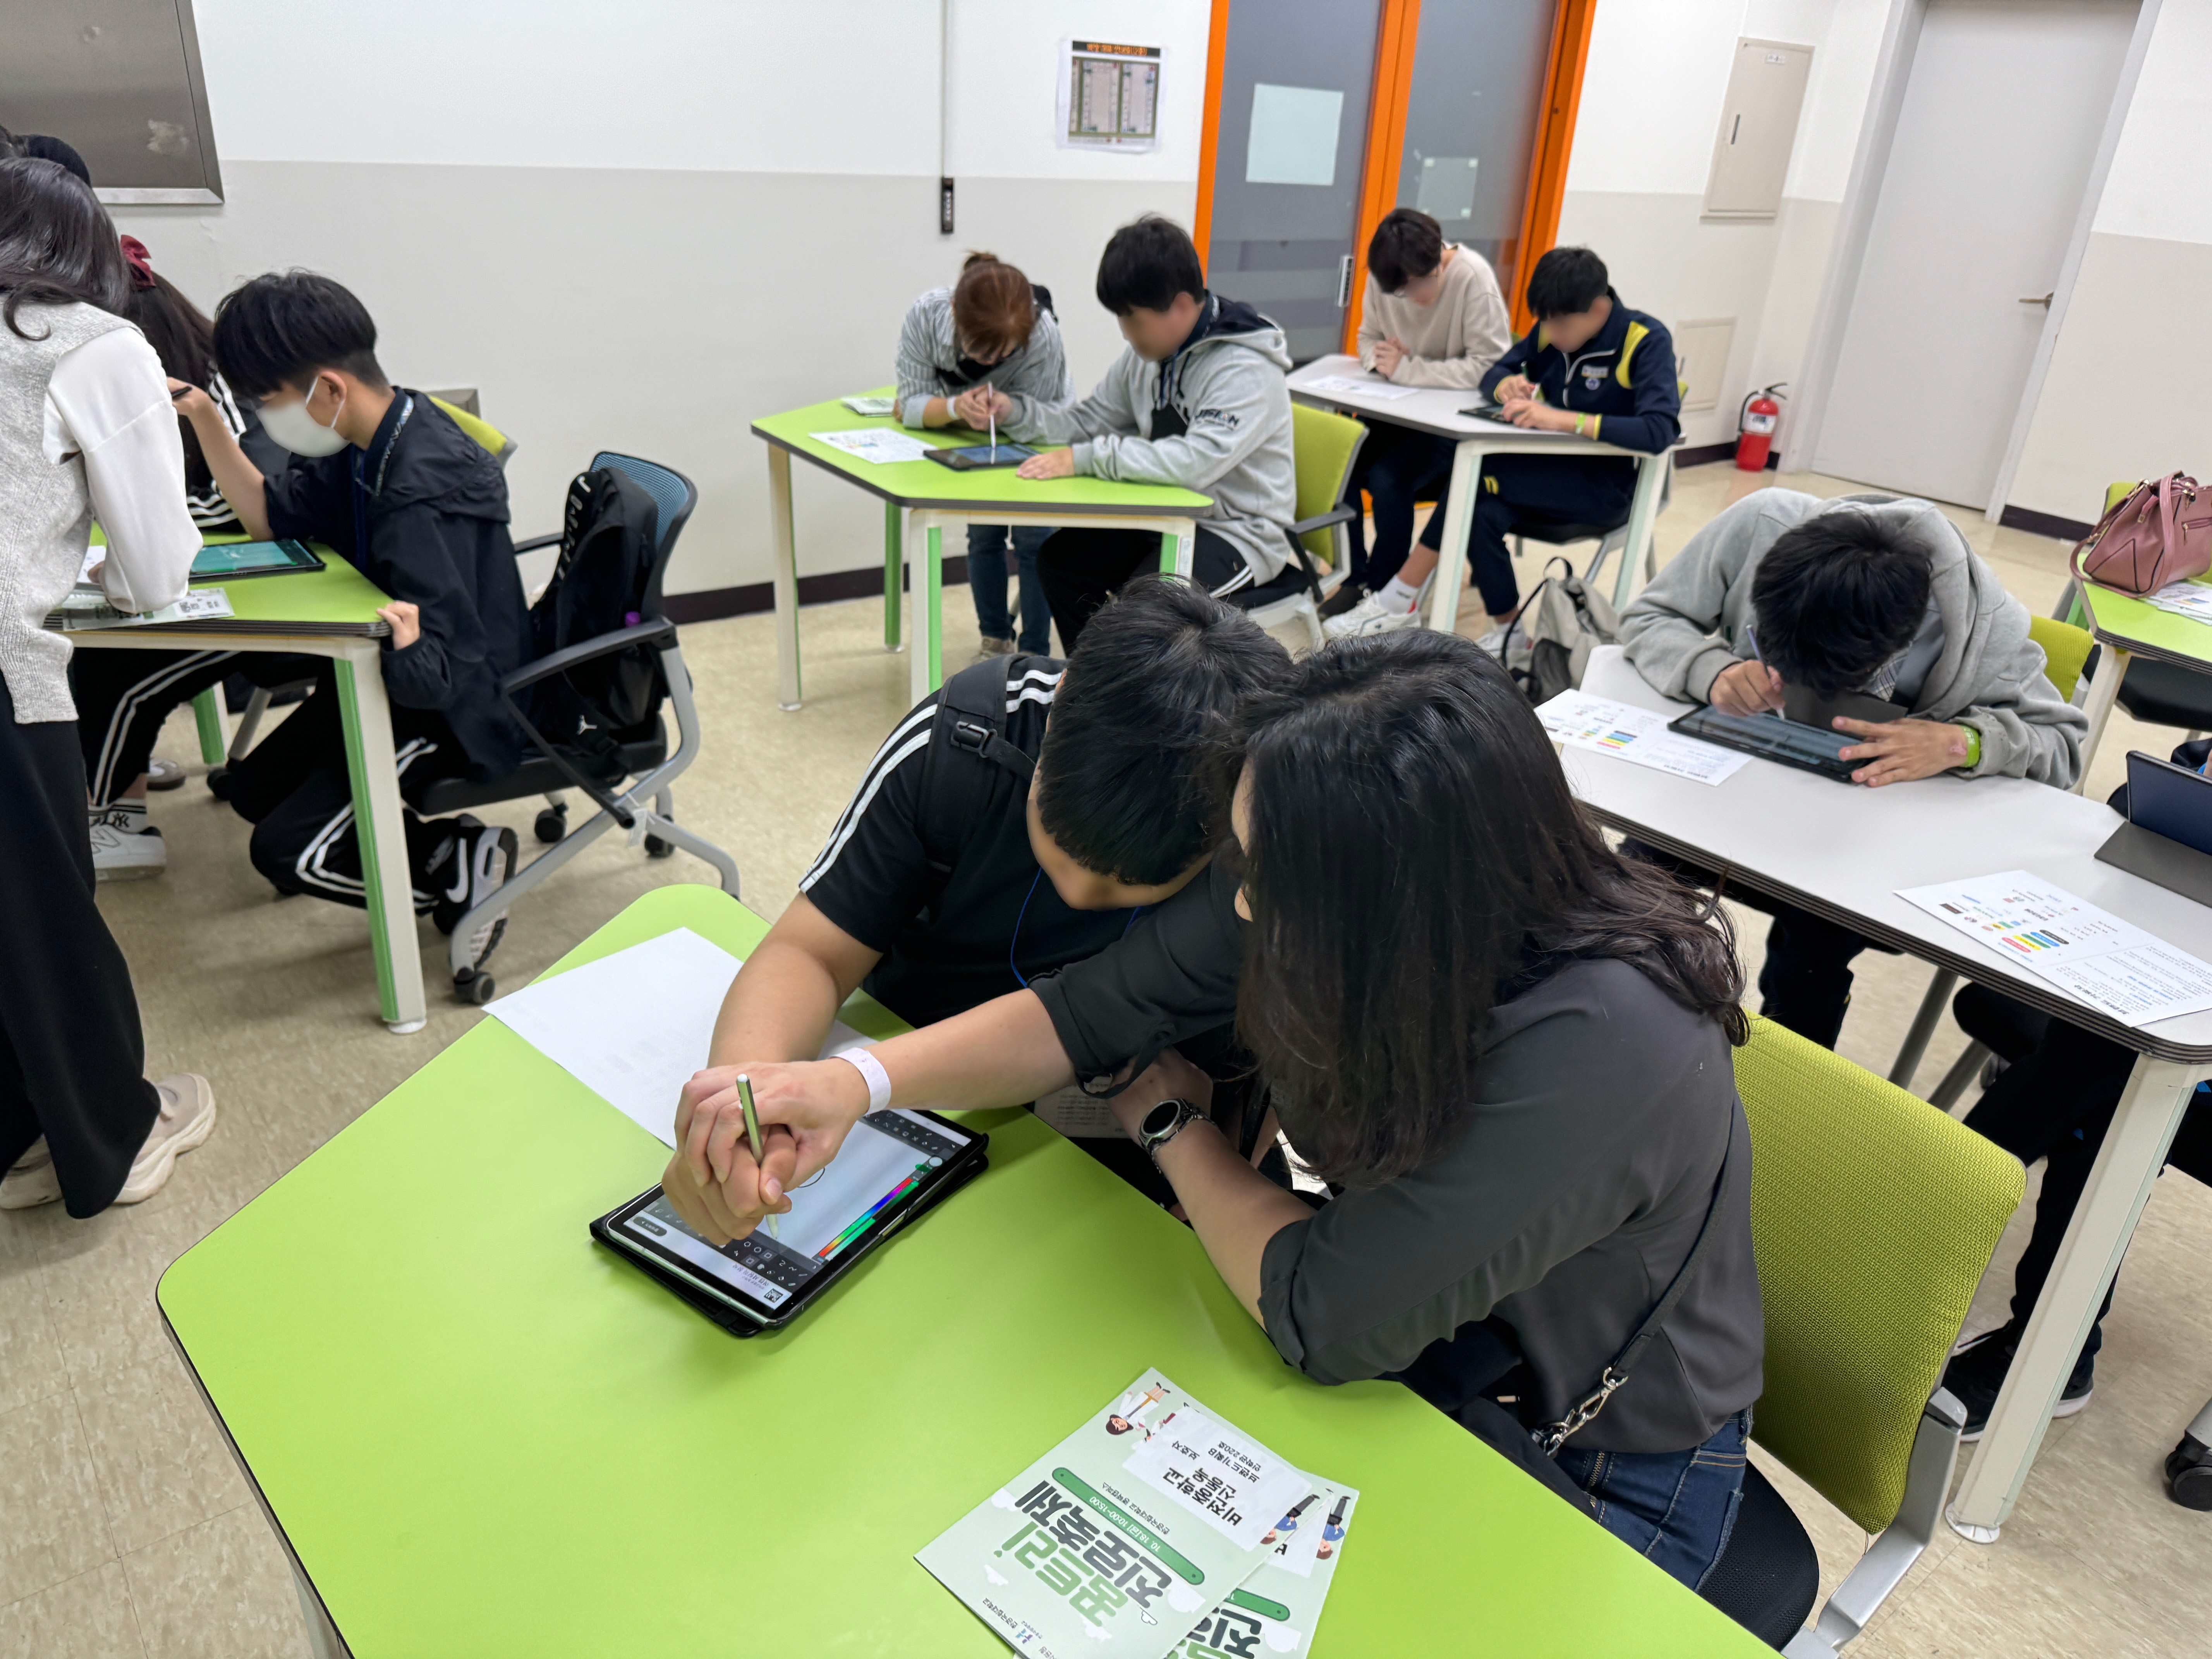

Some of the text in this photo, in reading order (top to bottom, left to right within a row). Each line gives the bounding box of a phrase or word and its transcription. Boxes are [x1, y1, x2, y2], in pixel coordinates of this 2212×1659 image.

[1171, 1440, 1200, 1460] 보호자
[1217, 1441, 1240, 1458] 220호
[1162, 1467, 1243, 1527] 비전중학교
[1192, 1467, 1237, 1500] 신동옥
[1014, 1480, 1172, 1609] 진로축제
[1001, 1520, 1129, 1627] 꿈트리
